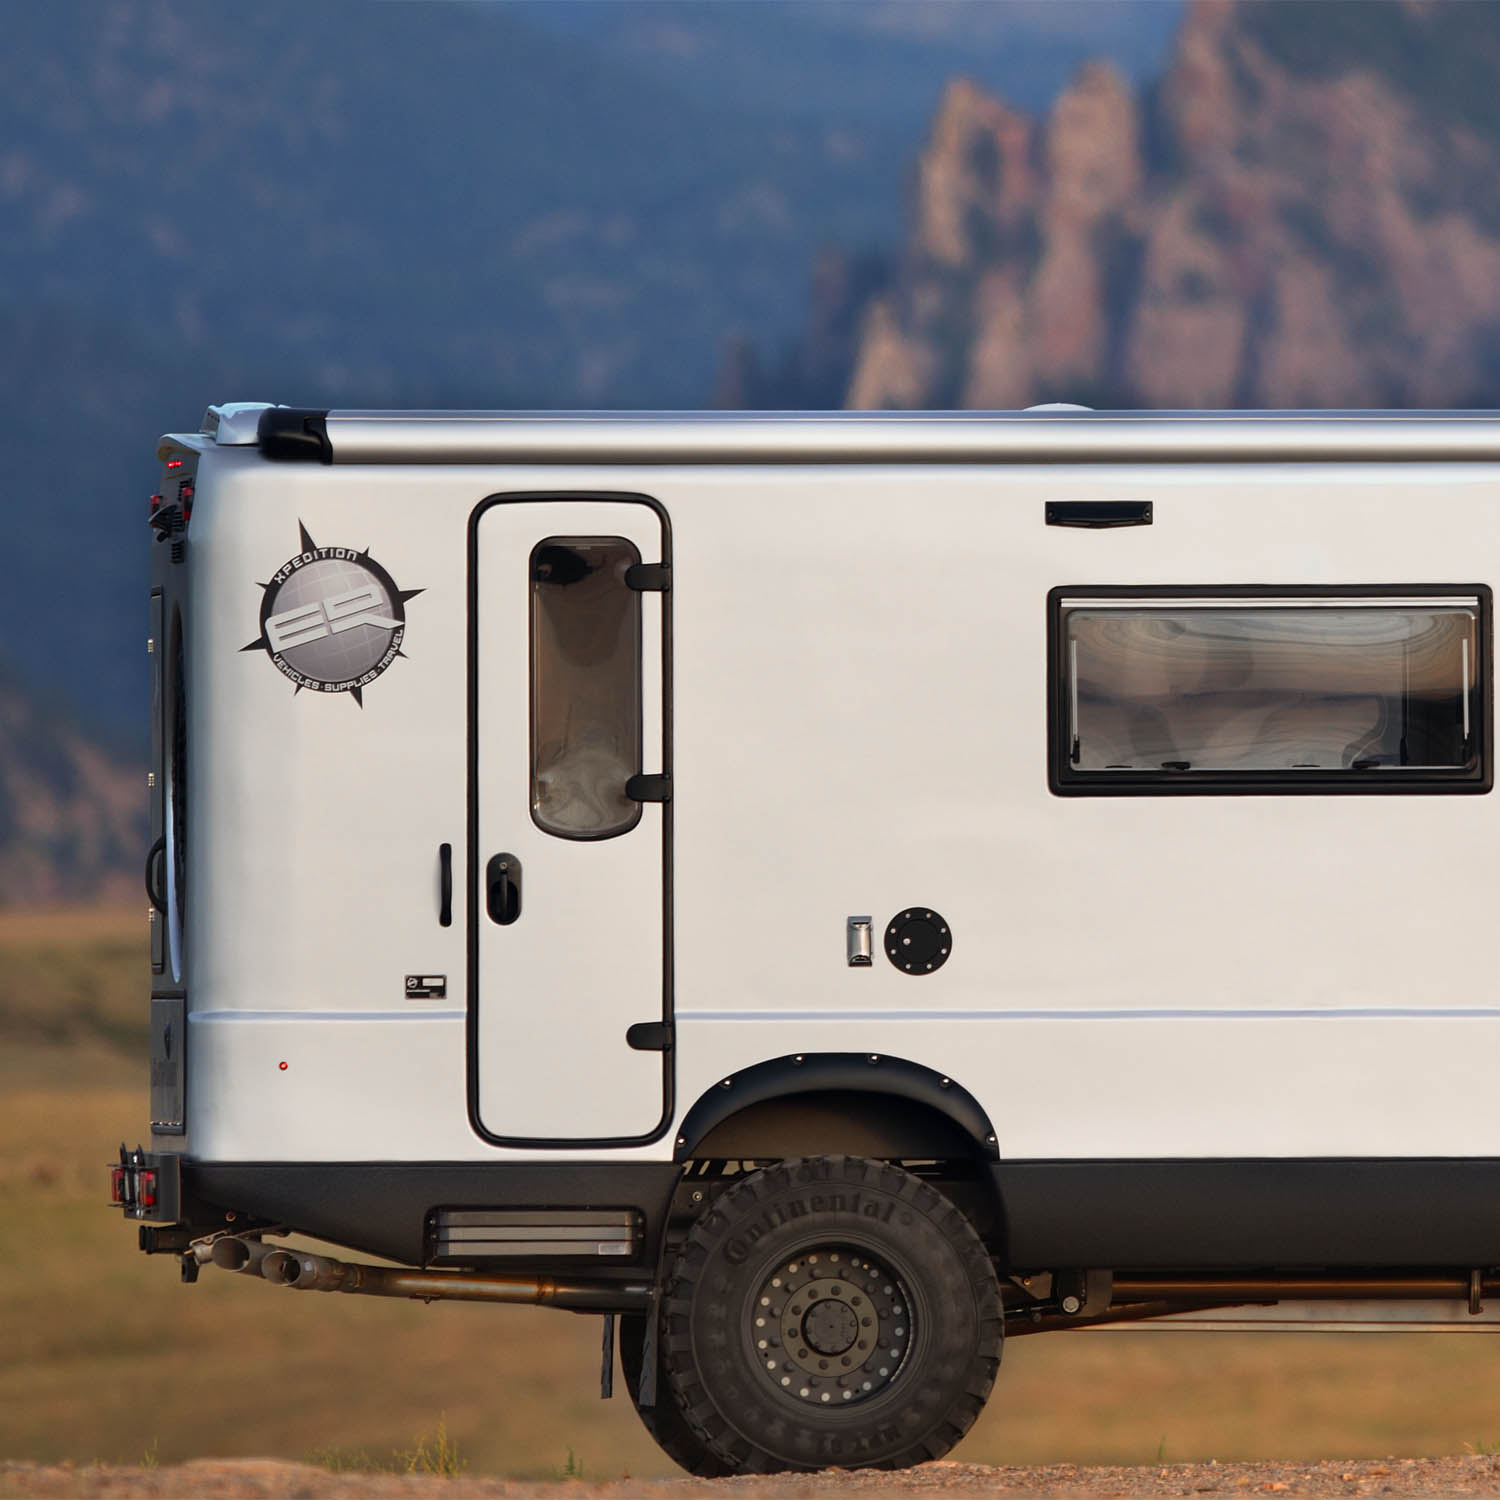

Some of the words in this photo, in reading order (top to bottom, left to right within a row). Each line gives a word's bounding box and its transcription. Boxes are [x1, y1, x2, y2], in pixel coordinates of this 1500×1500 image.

[274, 548, 358, 584] XPEDITION
[273, 653, 321, 691] VEHICLES
[324, 668, 379, 692] SUPPLIES
[377, 628, 404, 670] TRAVEL
